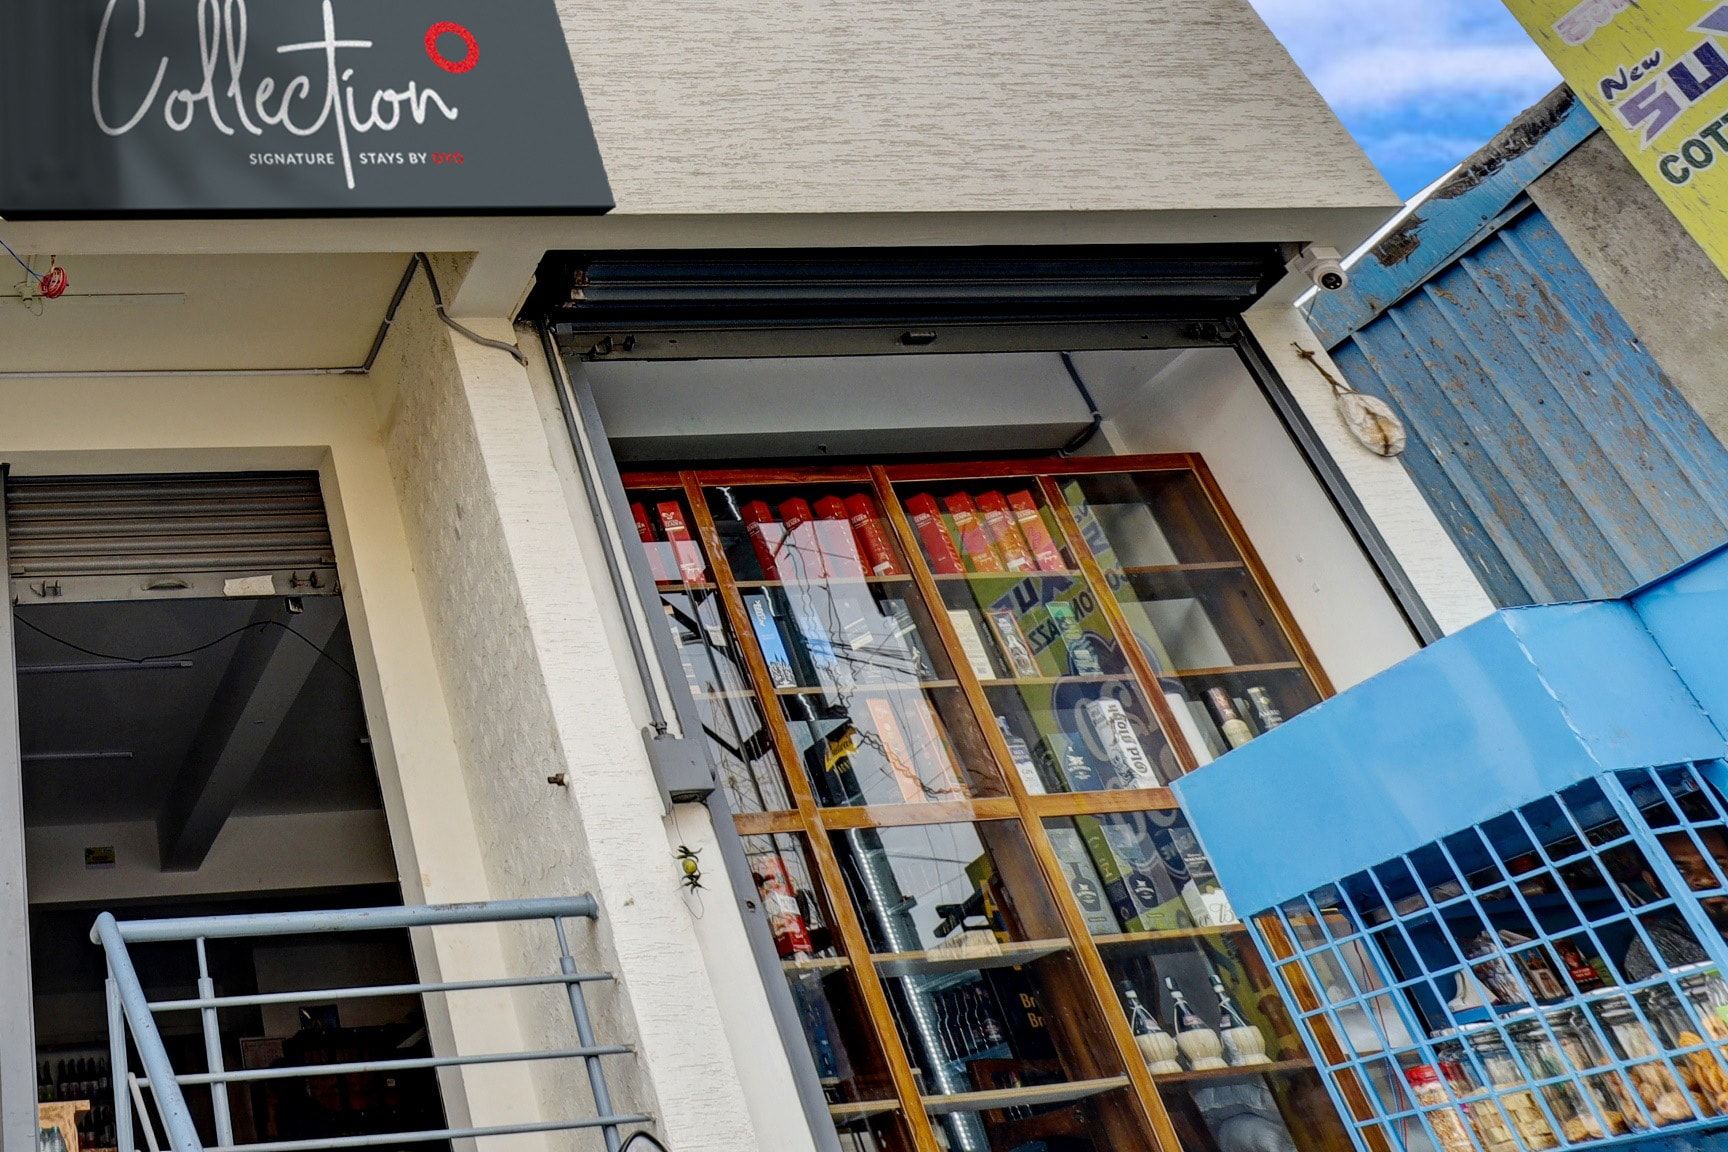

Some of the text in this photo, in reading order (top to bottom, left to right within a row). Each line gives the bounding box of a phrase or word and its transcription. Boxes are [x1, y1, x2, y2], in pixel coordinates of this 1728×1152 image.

[1600, 50, 1662, 101] New
[248, 152, 335, 165] SIGNATURE
[358, 152, 404, 165] STAYS
[408, 152, 427, 165] BY
